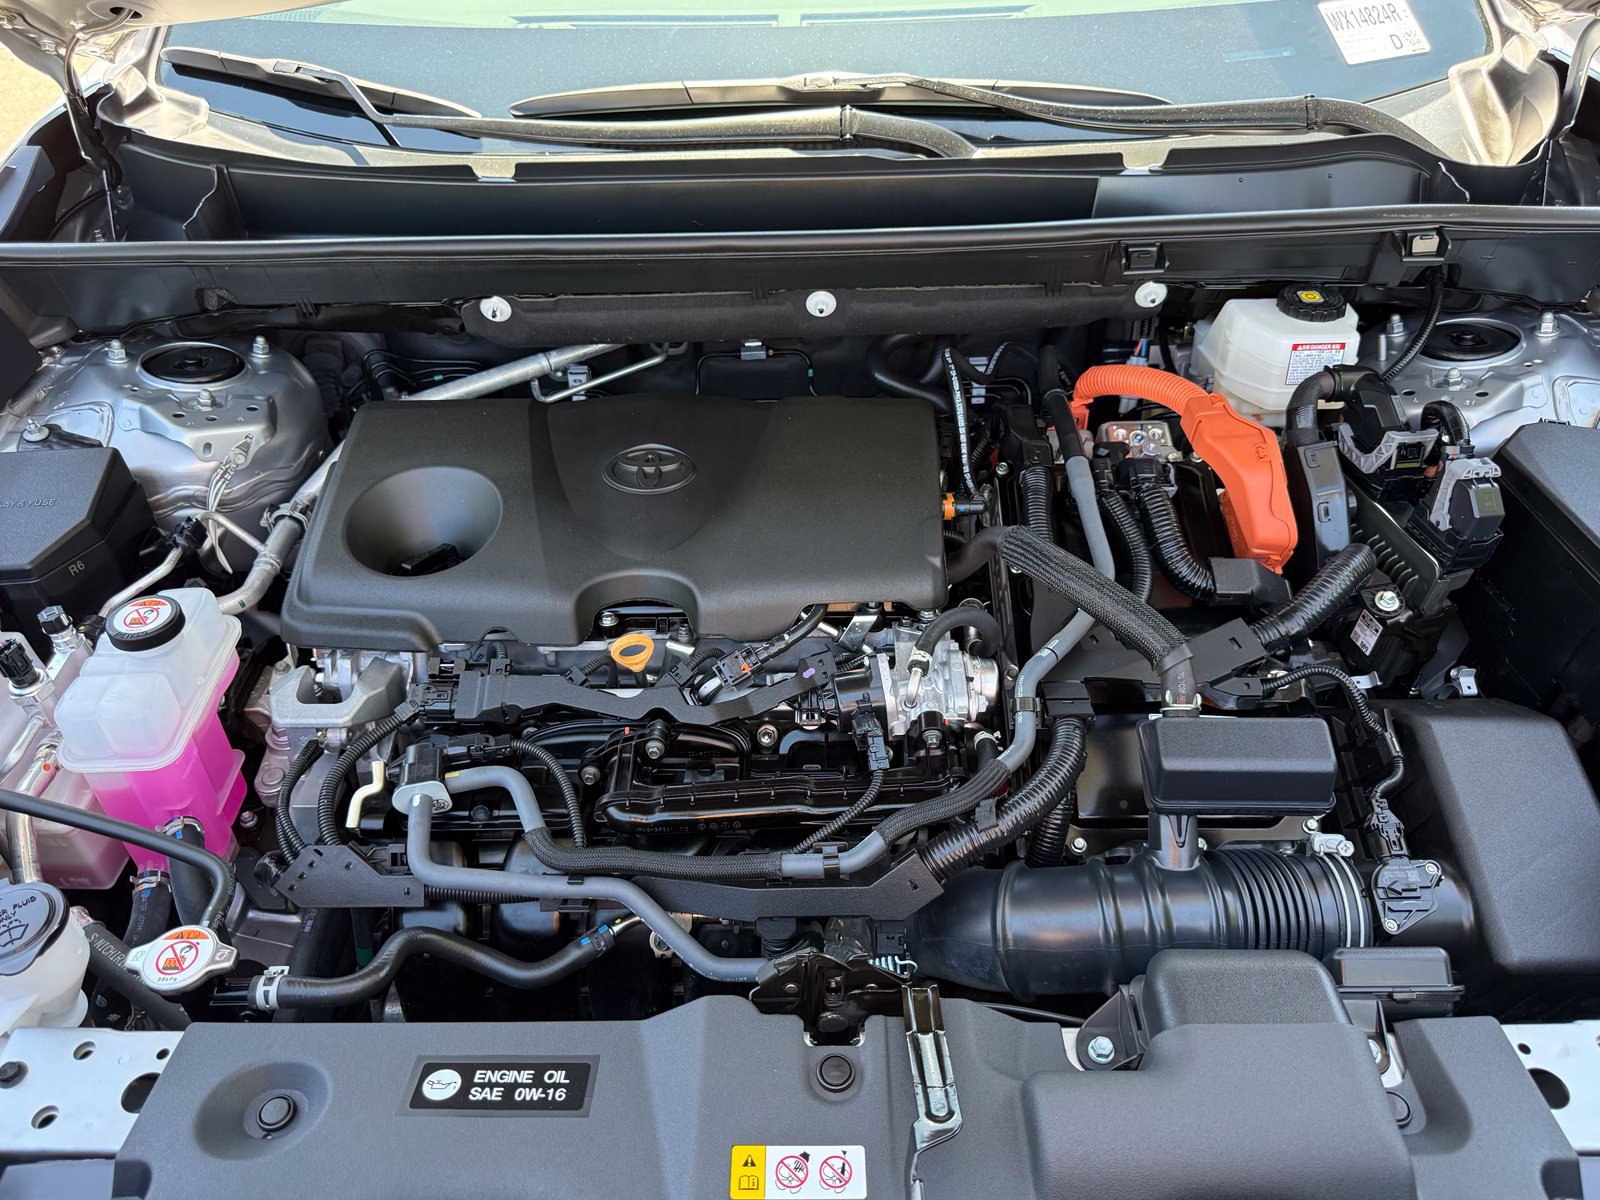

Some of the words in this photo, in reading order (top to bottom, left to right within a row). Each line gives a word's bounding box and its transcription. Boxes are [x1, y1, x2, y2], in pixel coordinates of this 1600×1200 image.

[1325, 2, 1402, 31] WX14824R
[1389, 34, 1404, 50] D
[28, 499, 57, 508] FUSE
[68, 560, 85, 577] R6
[473, 1069, 535, 1084] ENGINE
[543, 1069, 570, 1084] OIL
[468, 1087, 505, 1101] SAE
[514, 1087, 567, 1101] 0W-16
